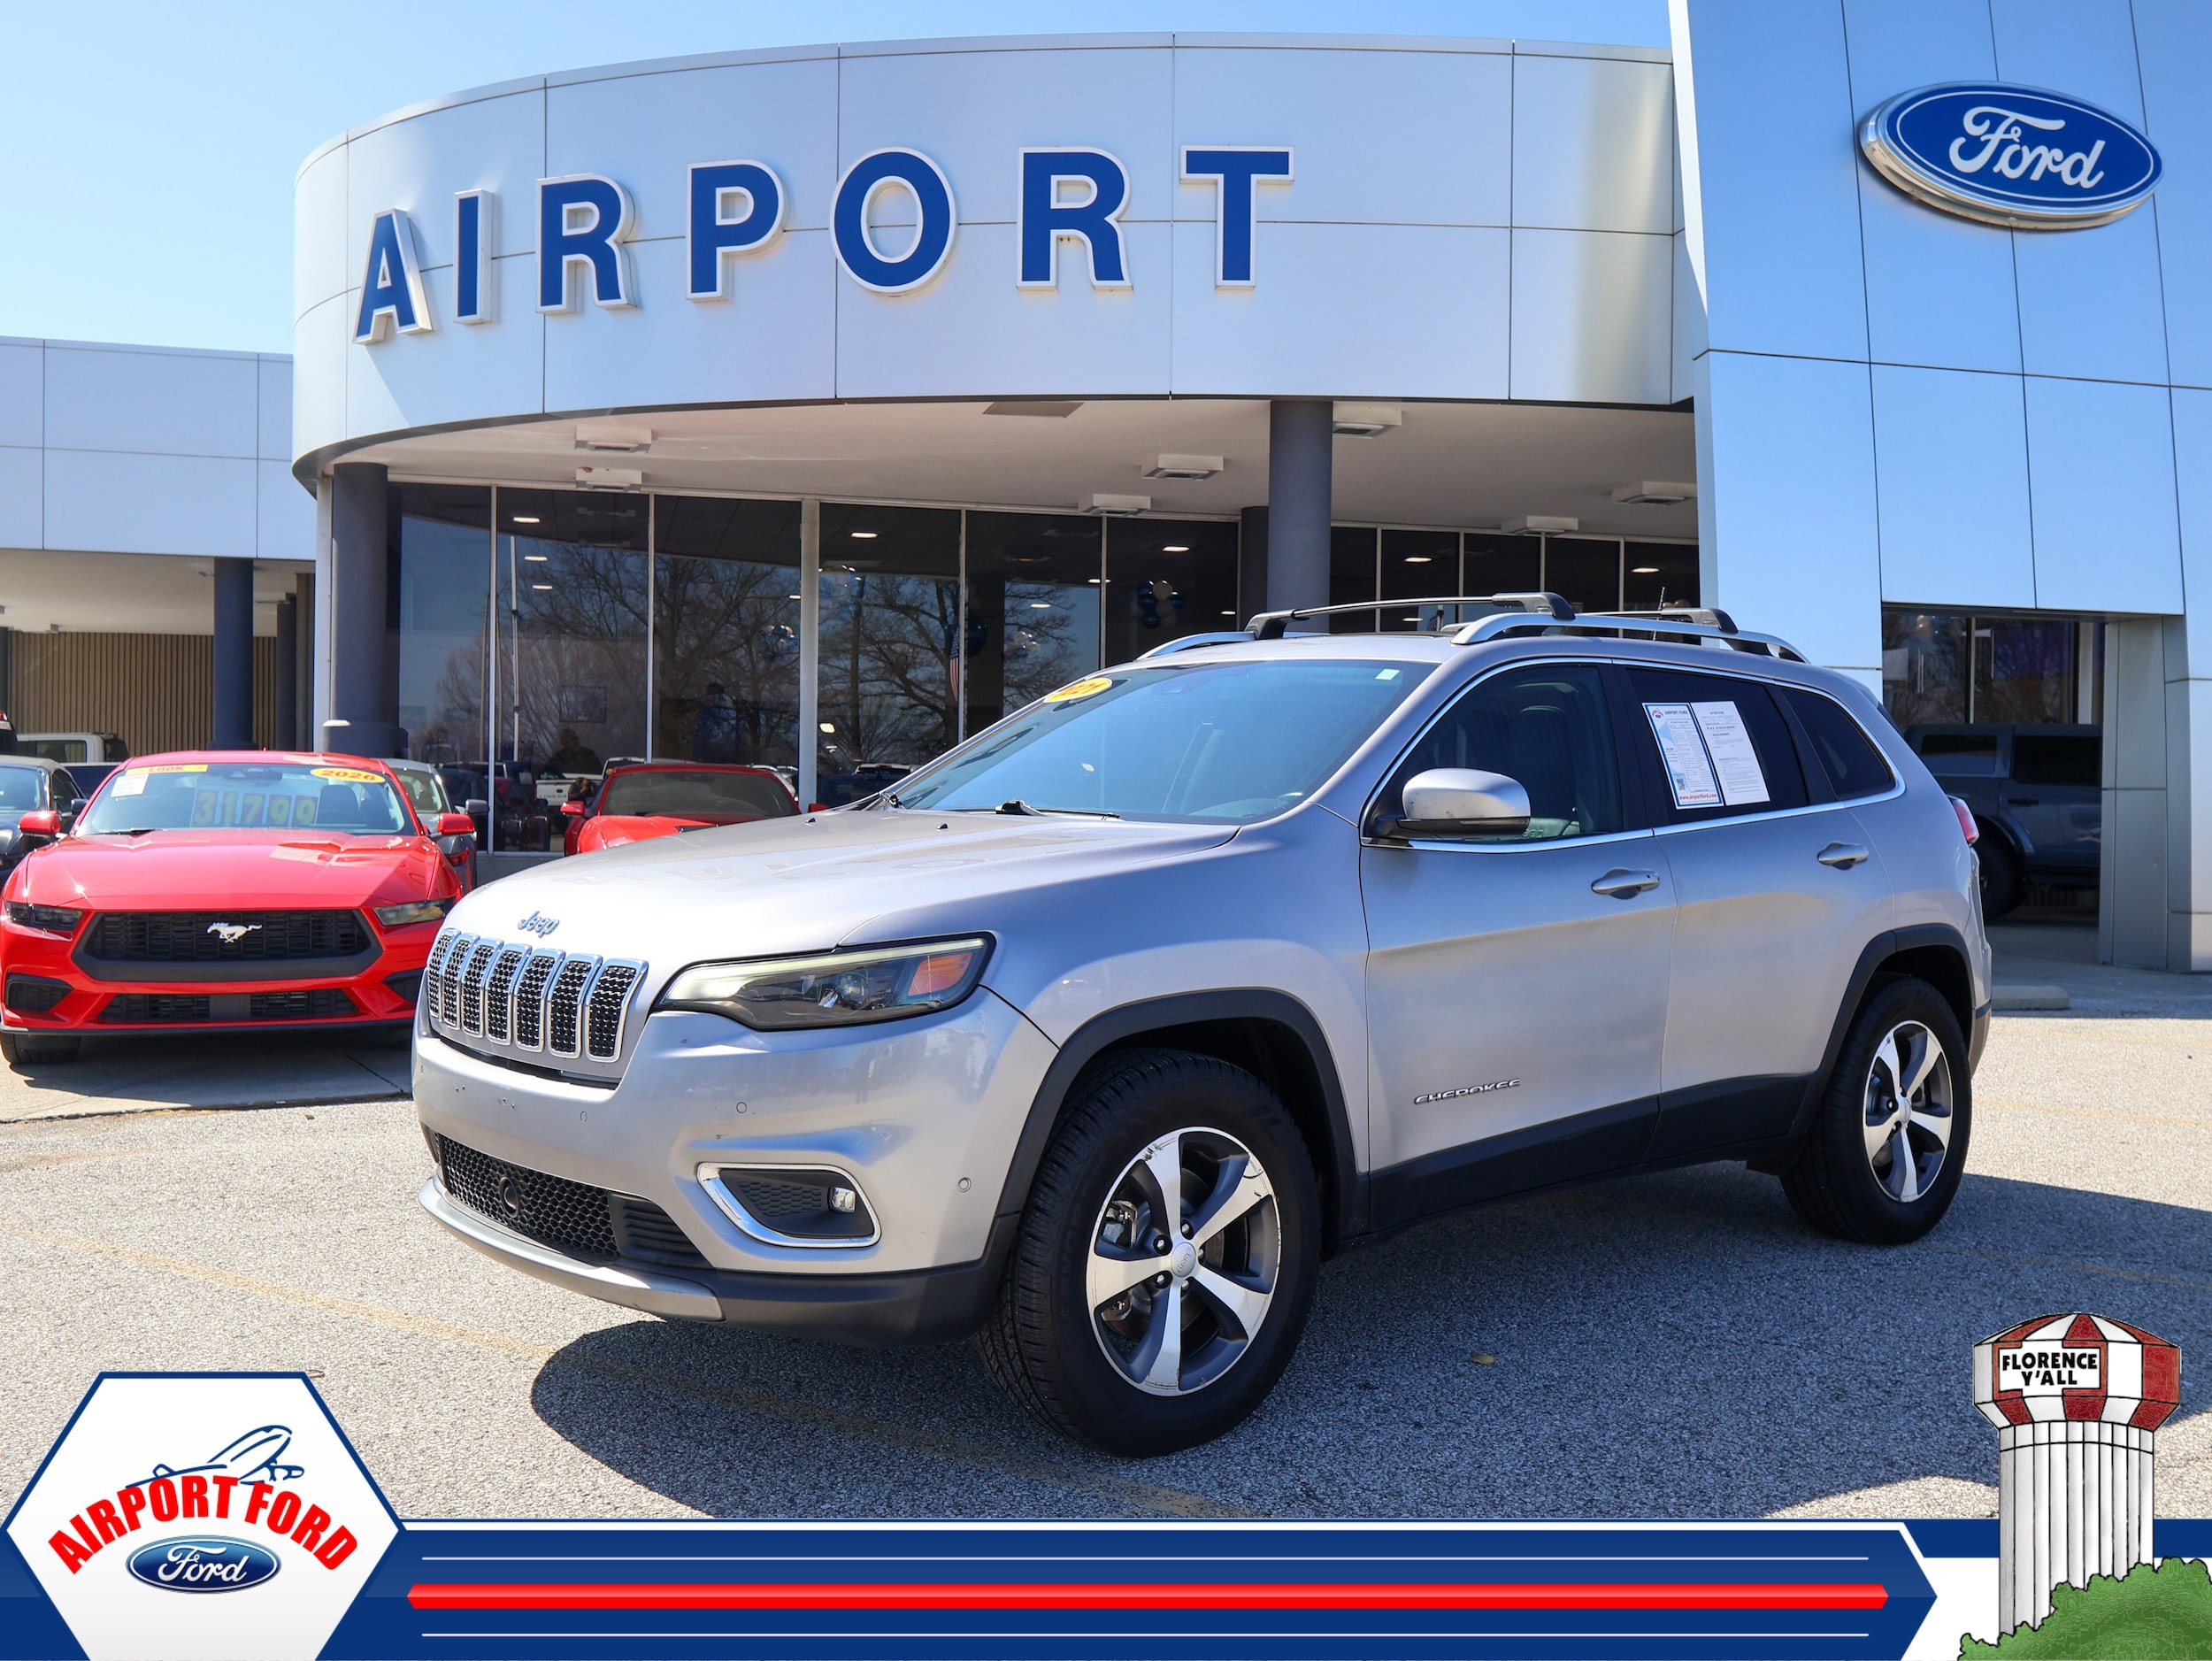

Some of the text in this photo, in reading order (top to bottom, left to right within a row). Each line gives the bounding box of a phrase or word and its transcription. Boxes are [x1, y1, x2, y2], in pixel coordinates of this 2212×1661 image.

[1949, 106, 2106, 188] Ford
[351, 144, 1294, 344] AIRPORT
[319, 770, 376, 781] 2026
[194, 790, 316, 826] 31799
[517, 911, 560, 938] Jeep
[1414, 1078, 1520, 1104] CHEROKEE
